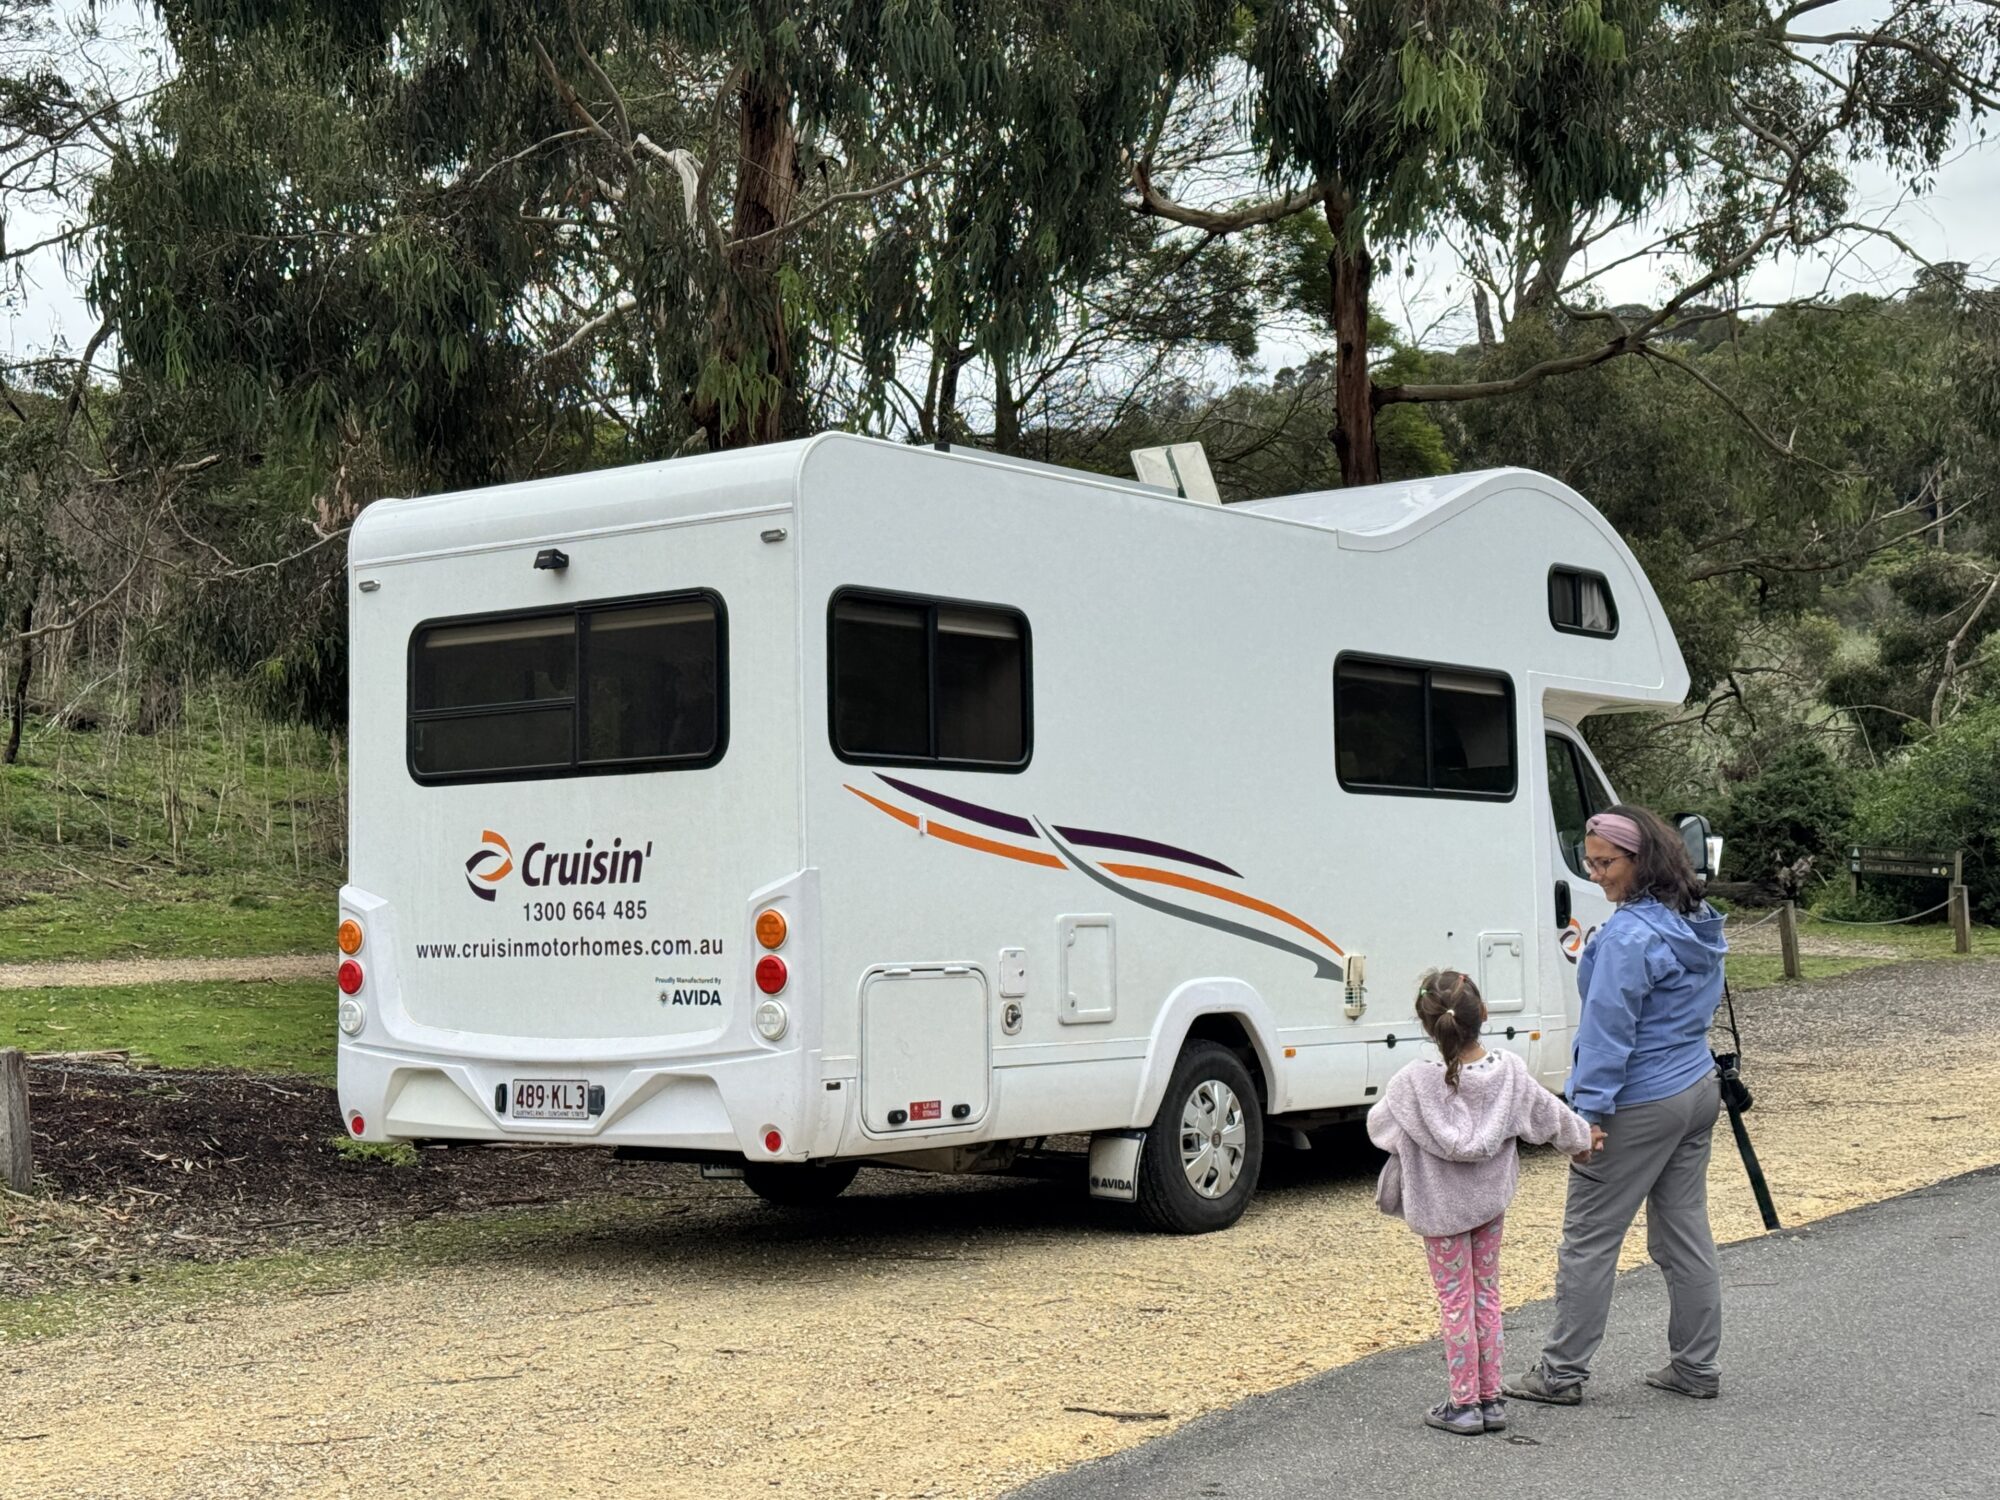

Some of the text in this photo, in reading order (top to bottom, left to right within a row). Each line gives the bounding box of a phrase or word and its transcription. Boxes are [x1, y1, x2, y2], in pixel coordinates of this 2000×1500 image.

[521, 837, 653, 887] Cruisin'
[523, 900, 647, 922] 1300 664 485
[415, 936, 724, 959] www.cruisinmotorhomes.com.au
[672, 989, 722, 1006] AVIDA
[1101, 1178, 1132, 1190] AVIDA
